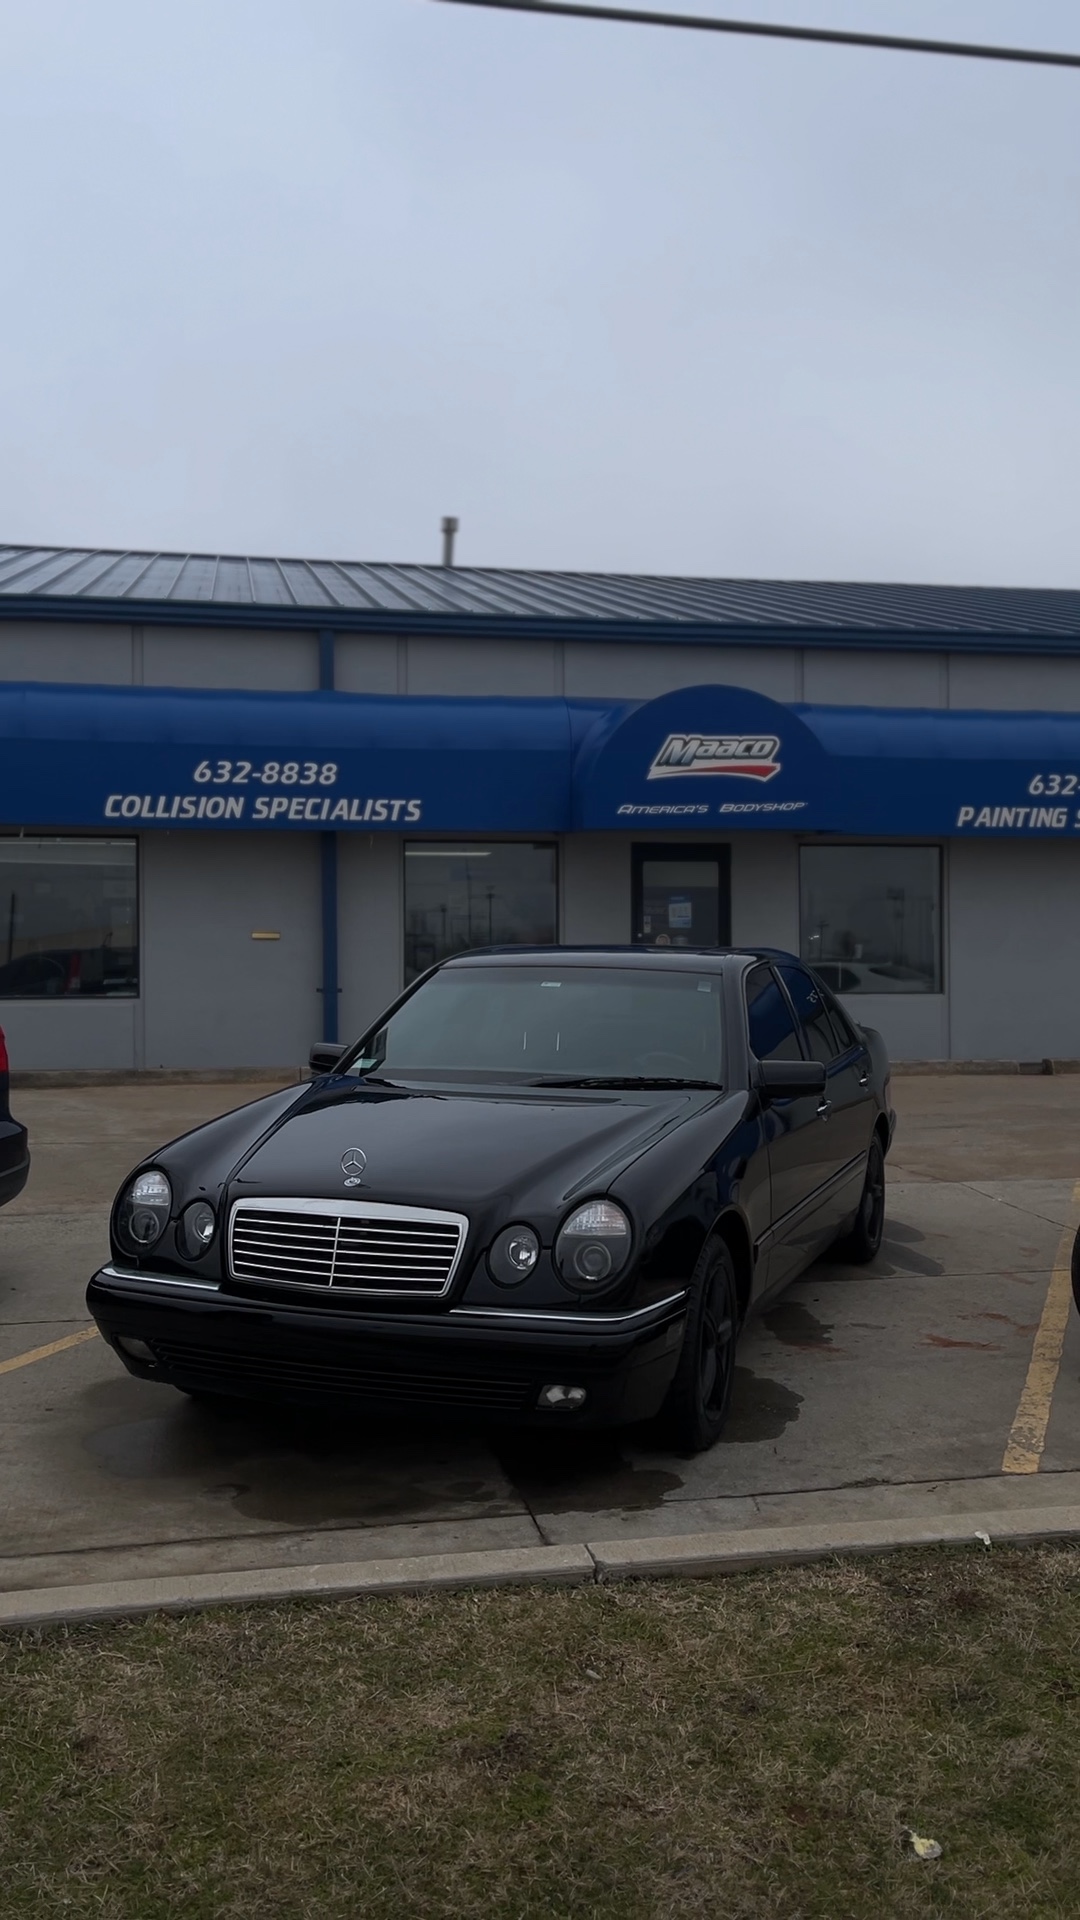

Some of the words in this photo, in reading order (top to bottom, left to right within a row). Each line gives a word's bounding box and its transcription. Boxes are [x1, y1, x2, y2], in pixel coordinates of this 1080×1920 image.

[655, 736, 778, 767] Maaco
[193, 760, 338, 785] 632-8838
[1028, 774, 1080, 796] 632
[104, 795, 245, 819] COLLISION
[252, 797, 422, 822] SPECIALISTS
[957, 806, 1068, 828] PAINTING
